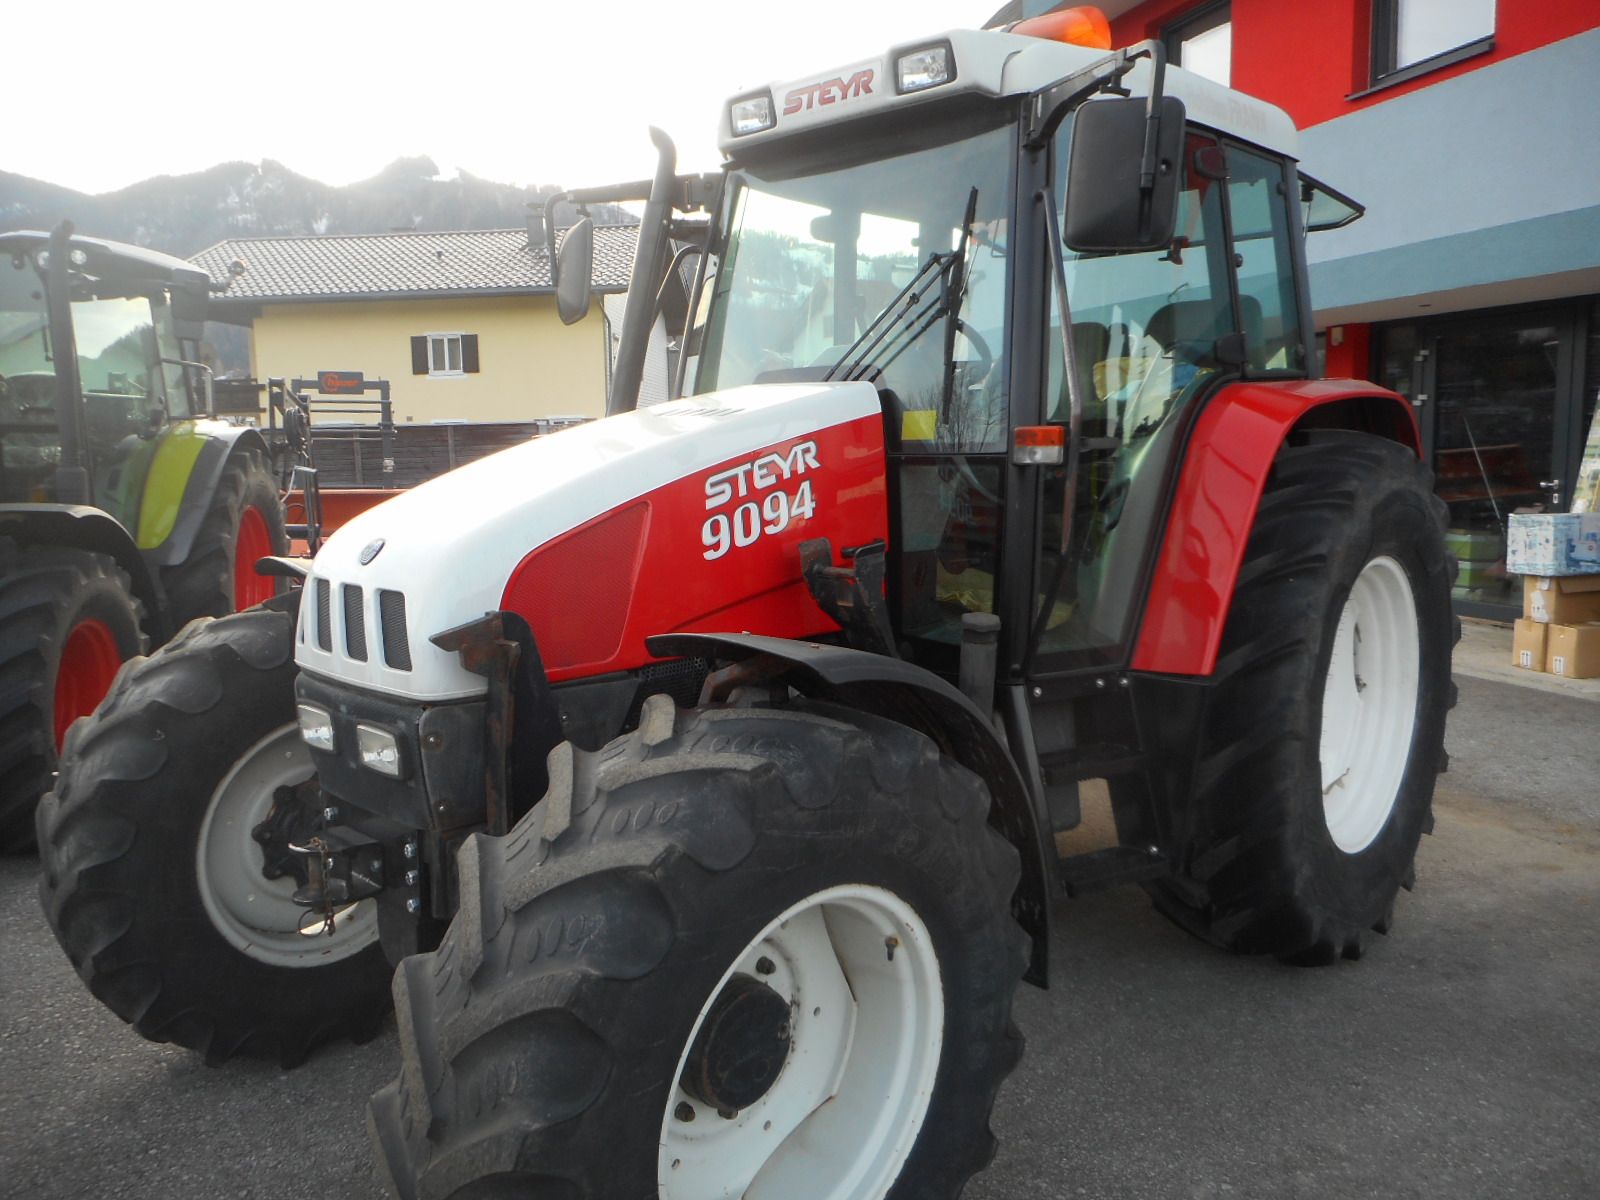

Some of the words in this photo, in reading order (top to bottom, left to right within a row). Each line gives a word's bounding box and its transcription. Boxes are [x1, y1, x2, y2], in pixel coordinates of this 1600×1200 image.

[783, 69, 874, 116] STEYR
[704, 441, 821, 511] STEYR
[701, 480, 816, 561] 9094
